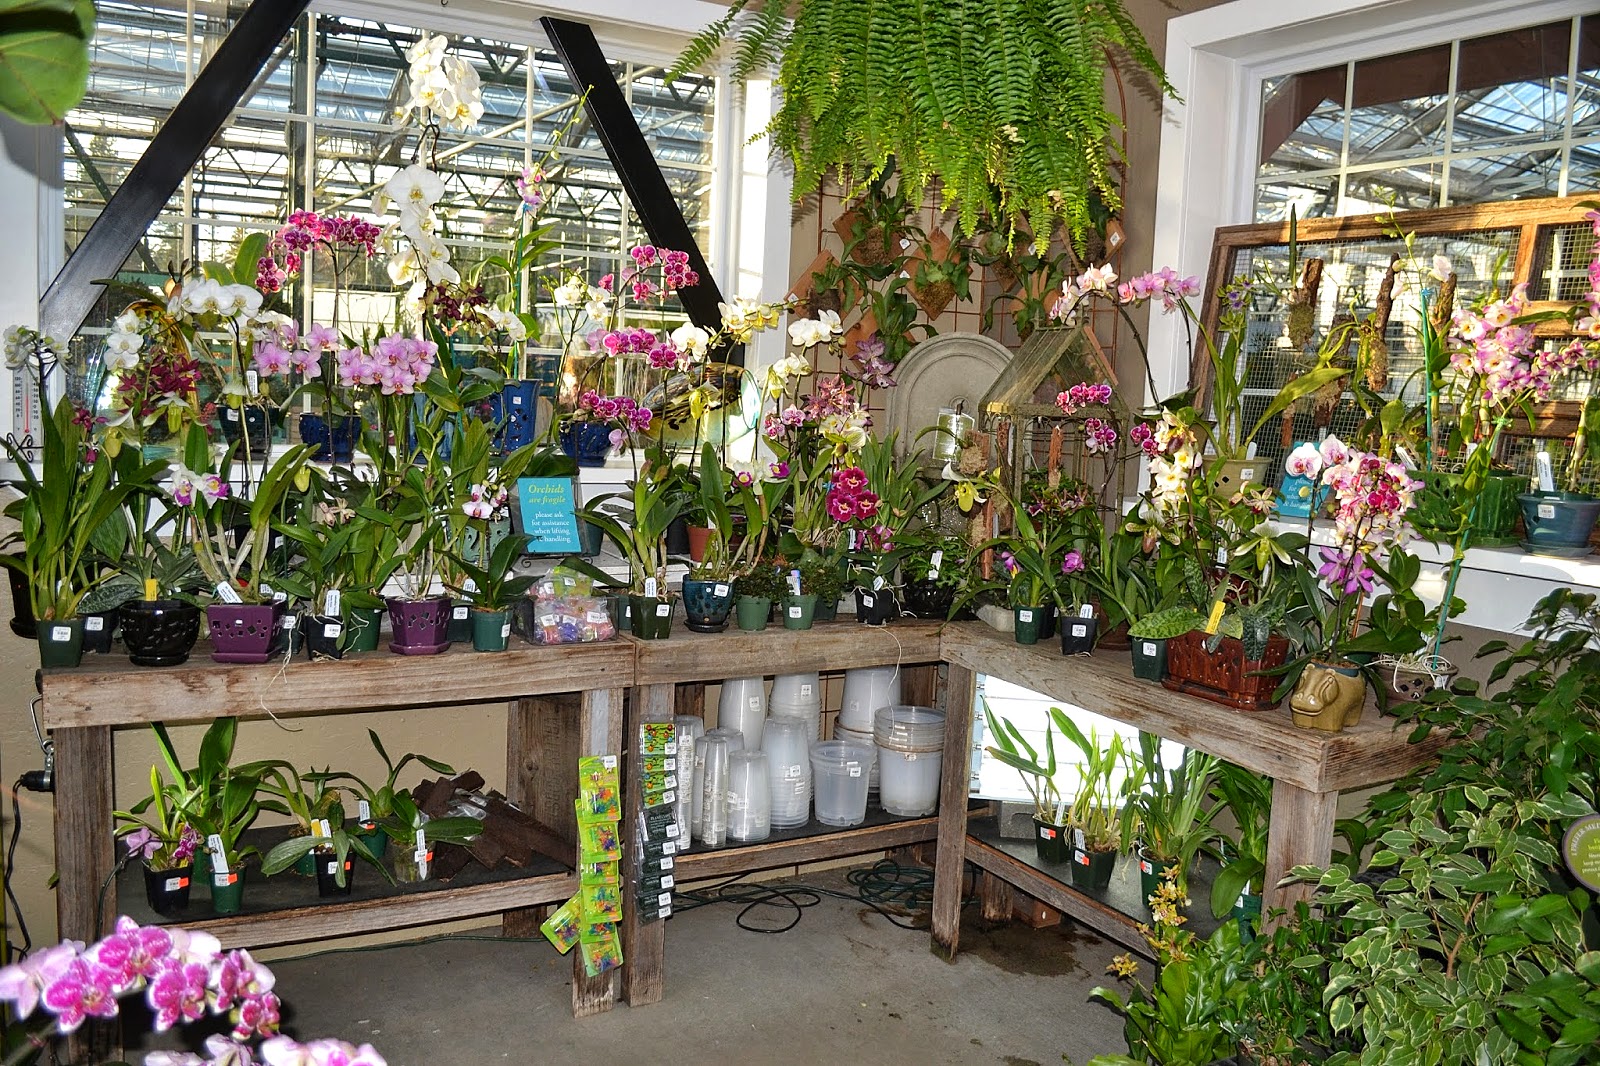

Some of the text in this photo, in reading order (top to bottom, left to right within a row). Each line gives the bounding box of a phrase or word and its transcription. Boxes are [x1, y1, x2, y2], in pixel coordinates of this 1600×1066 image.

[528, 484, 564, 494] Orchids
[541, 495, 566, 505] fragile
[535, 511, 552, 519] please
